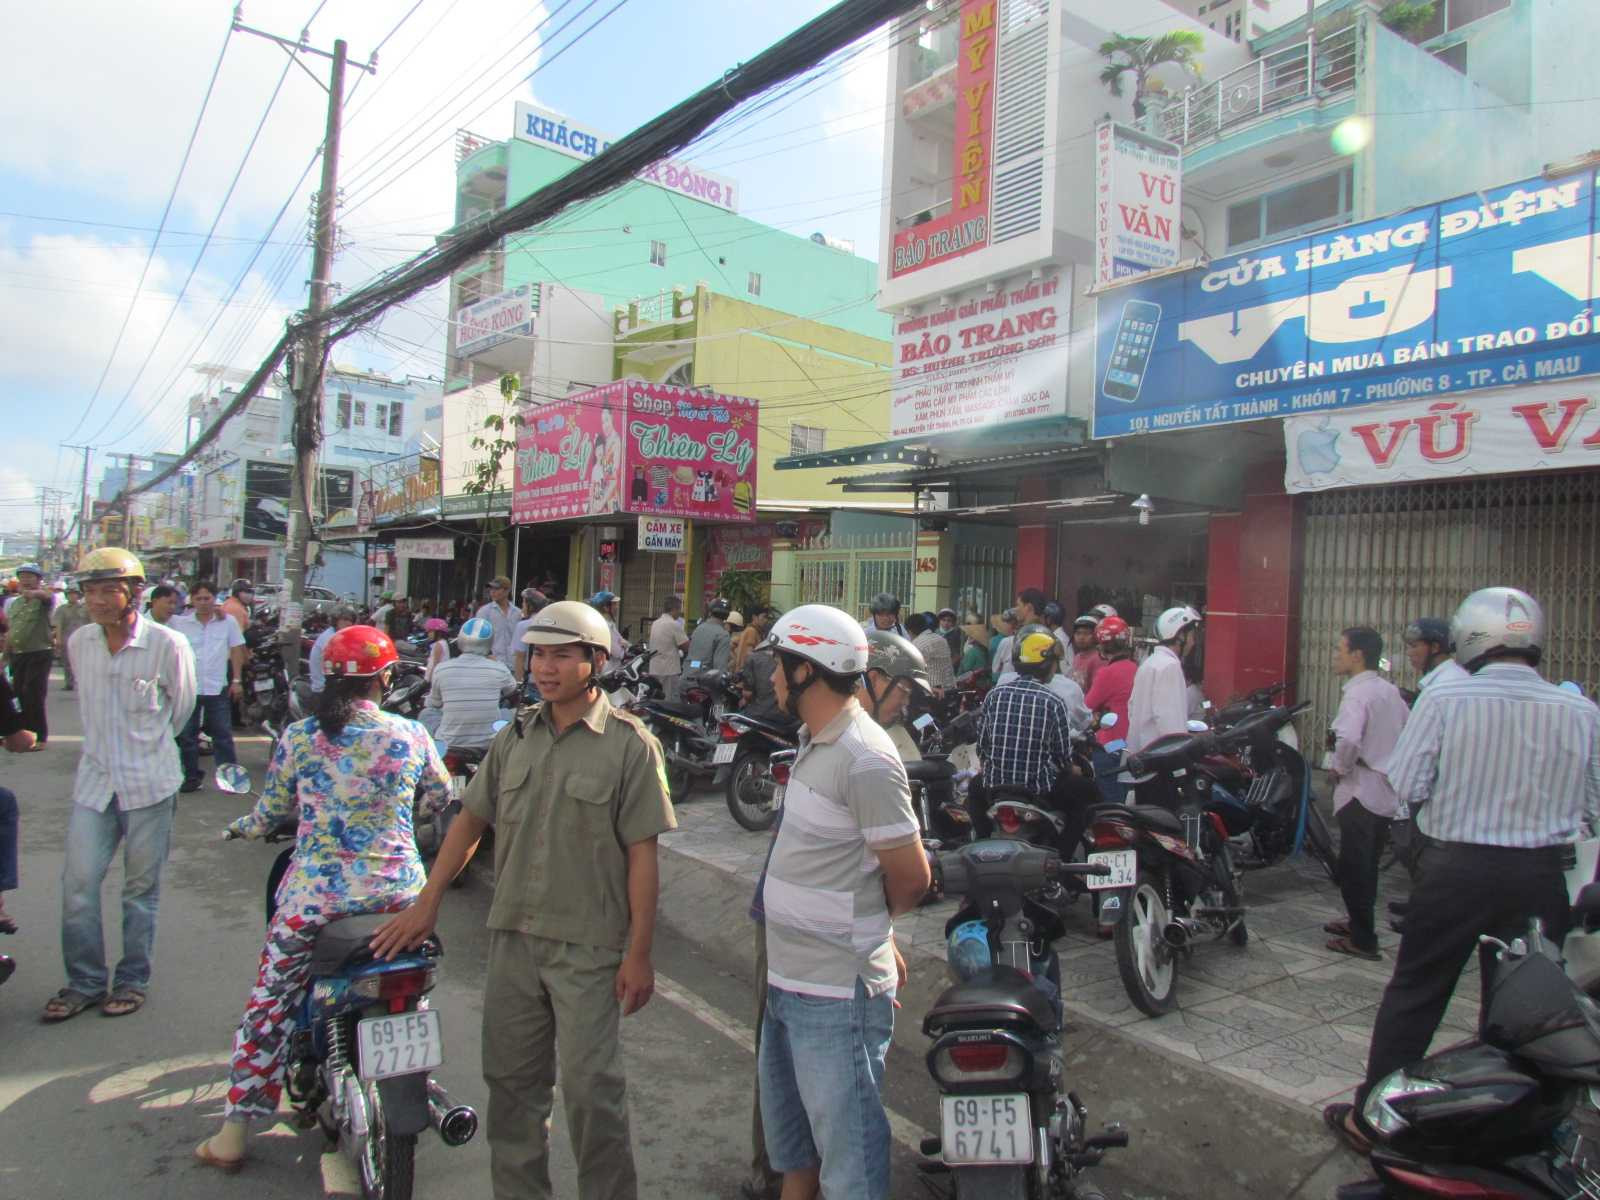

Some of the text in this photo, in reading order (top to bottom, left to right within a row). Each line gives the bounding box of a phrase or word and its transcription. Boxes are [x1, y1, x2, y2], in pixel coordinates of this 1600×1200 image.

[526, 113, 598, 157] KHÁCH
[665, 165, 721, 203] ĐÔNG
[1139, 171, 1177, 204] VŨ
[1118, 204, 1173, 243] VĂN
[1200, 181, 1582, 294] CỬA HÀNG ĐIỆN
[895, 217, 985, 270] BẢO TRANG
[900, 306, 1058, 363] BẢO TRANG
[1235, 361, 1324, 389] CHUYÊN
[1332, 351, 1384, 374] MUA
[1393, 339, 1449, 365] BÁN
[1458, 327, 1536, 354] TRAO
[633, 393, 672, 419] Shop
[1129, 417, 1150, 431] 101
[1153, 404, 1201, 427] NGUYỄN
[1204, 403, 1227, 420] TẤT
[1232, 397, 1279, 417] THÀNH
[1292, 388, 1337, 409] KHÓM
[1341, 388, 1349, 401] 7
[1366, 377, 1433, 400] PHƯỜNG
[1438, 375, 1449, 390] 8
[1467, 369, 1496, 386] TP.
[1502, 360, 1528, 382] CÀ
[1535, 355, 1582, 377] MAU
[630, 421, 707, 461] Thiên
[1352, 400, 1481, 469] VŨ
[670, 522, 682, 534] XE
[917, 557, 937, 572] 143
[371, 1014, 429, 1046] 69-F5
[373, 1043, 431, 1075] 2727
[954, 1098, 1017, 1127] 69-F5
[955, 1130, 1017, 1159] 6741
